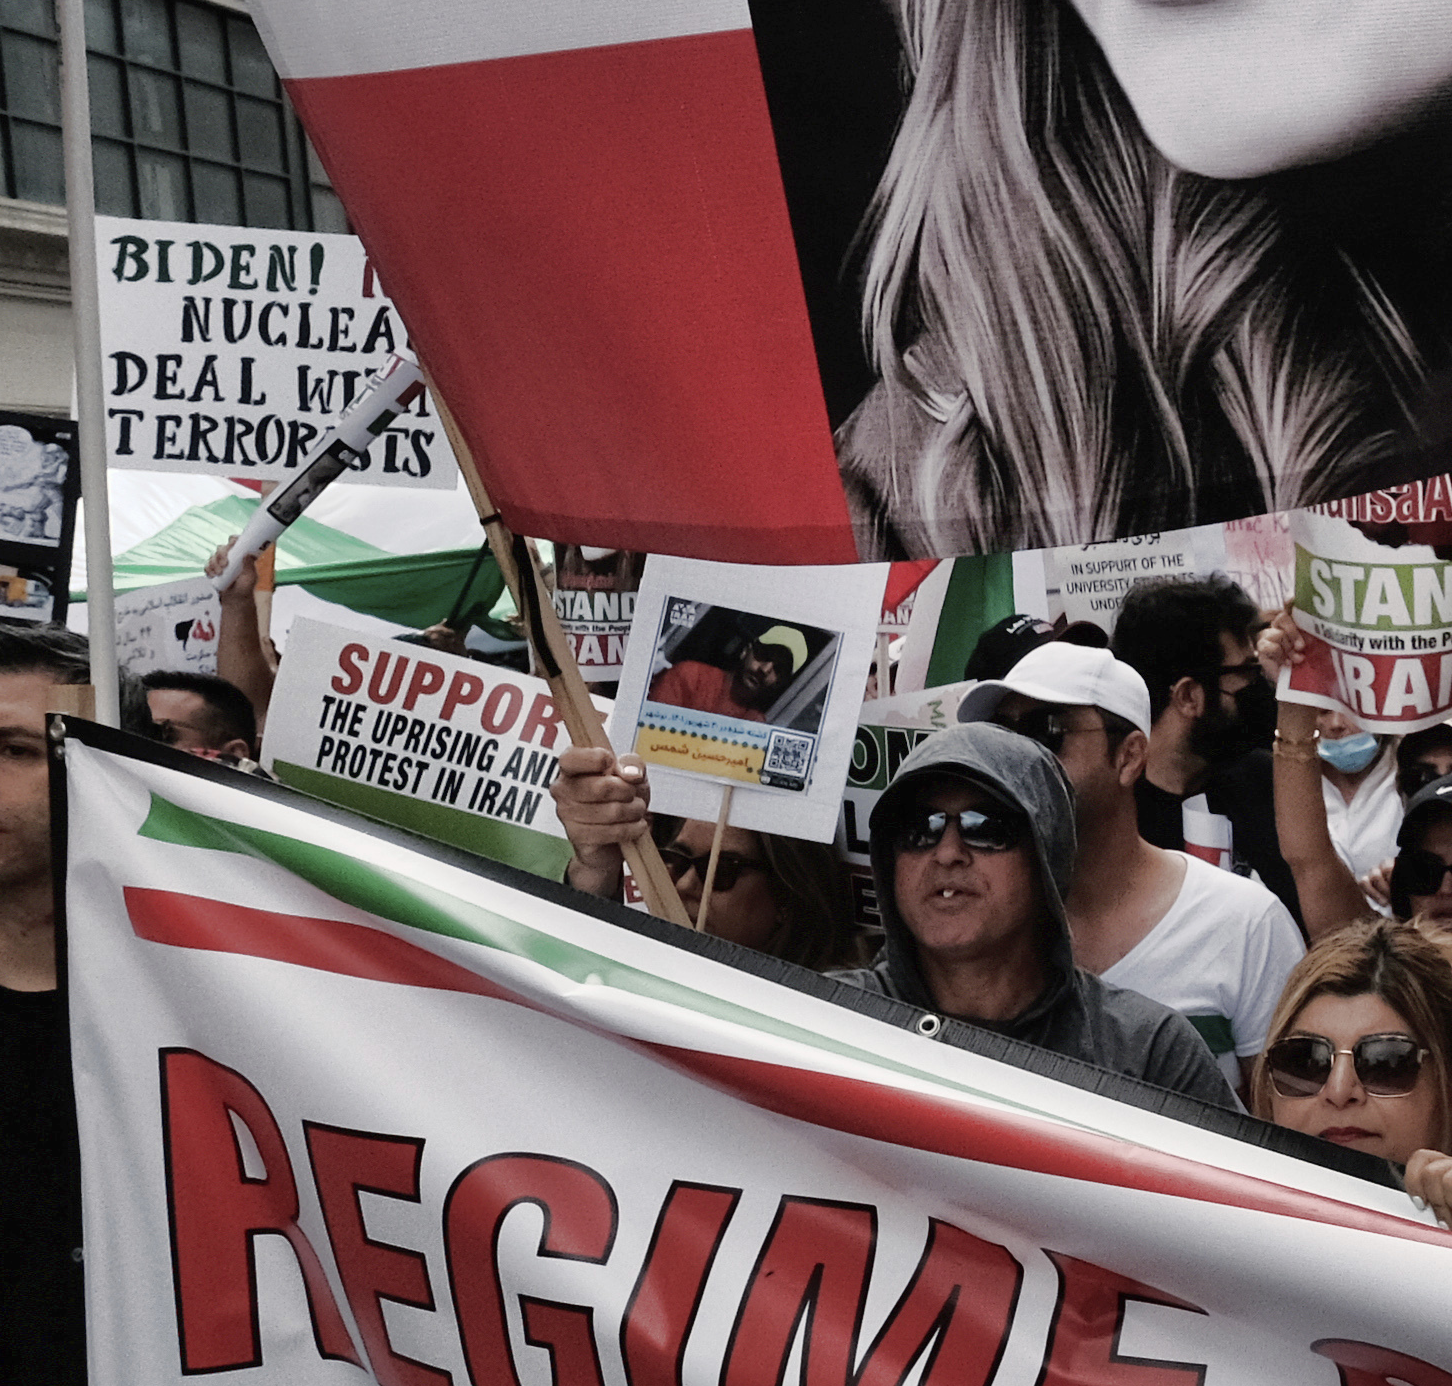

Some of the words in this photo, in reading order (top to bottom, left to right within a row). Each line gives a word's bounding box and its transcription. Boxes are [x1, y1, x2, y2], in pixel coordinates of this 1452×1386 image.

[110, 235, 325, 295] BIDEN!
[181, 296, 410, 354] NUCLEA
[108, 351, 266, 406] DEAL
[1066, 578, 1131, 595] UNIVERSITY
[1071, 564, 1084, 575] IN
[1140, 555, 1158, 569] OF
[1161, 554, 1184, 568] THE
[1090, 597, 1123, 612] UNDE
[1369, 631, 1406, 651] with
[1411, 633, 1438, 651] the
[331, 643, 566, 750] SUPPOR
[319, 695, 367, 738] THE
[371, 710, 499, 773] UPRISING
[501, 747, 559, 790] AND
[317, 736, 430, 794] PROTEST
[432, 767, 466, 805] IN
[468, 777, 543, 826] IRAN
